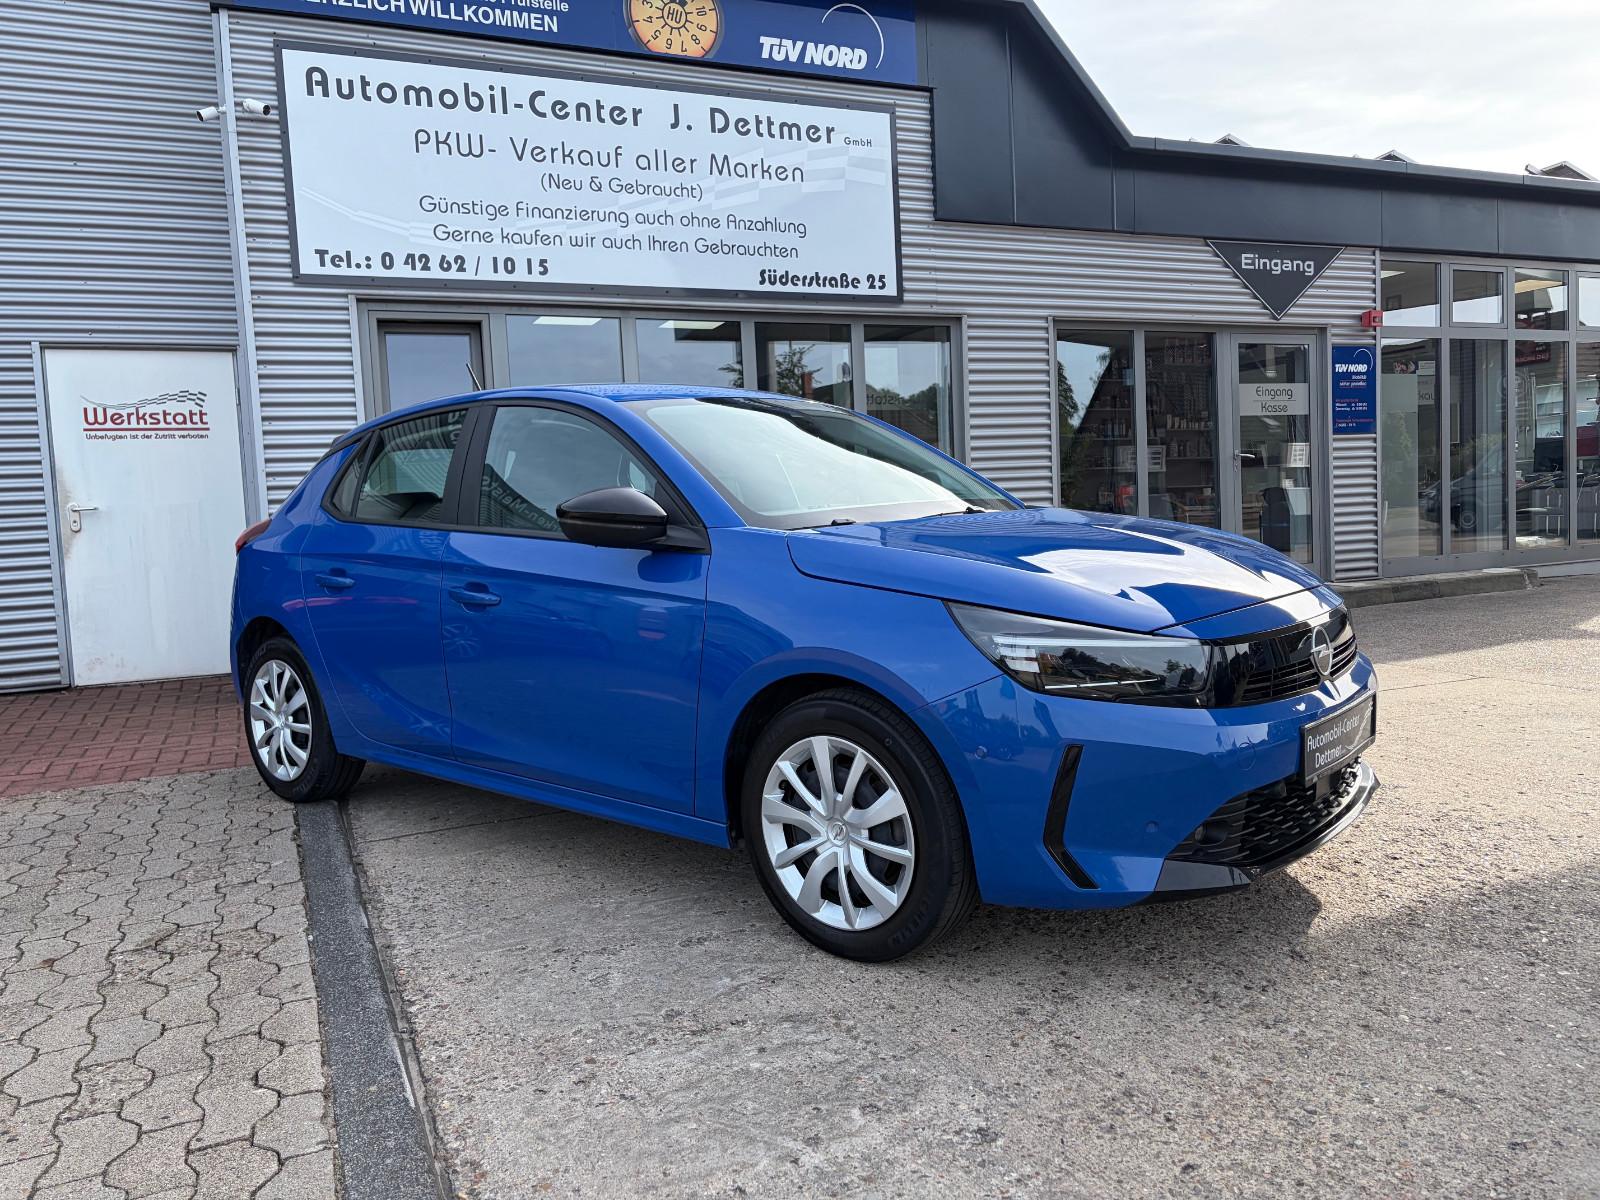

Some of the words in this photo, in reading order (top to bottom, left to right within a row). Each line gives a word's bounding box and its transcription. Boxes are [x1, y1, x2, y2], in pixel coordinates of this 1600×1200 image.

[408, 0, 558, 33] WILLKOMMEN
[666, 6, 683, 24] HU
[696, 5, 707, 17] 10
[804, 42, 868, 70] NORD
[305, 66, 643, 127] Automobil-Center
[670, 103, 693, 131] J.
[709, 107, 835, 144] Dettmer
[843, 136, 873, 148] GmbH
[414, 128, 497, 158] PKW-
[509, 136, 622, 168] Verkauf
[635, 148, 698, 174] aller
[709, 153, 804, 182] Marken
[540, 173, 583, 192] (Neu
[589, 176, 602, 192] &
[608, 177, 703, 201] Gebraucht)
[419, 195, 509, 221] Günstige
[516, 201, 629, 228] Finanzierung
[634, 210, 674, 227] auch
[680, 213, 721, 229] ohne
[727, 214, 807, 238] Anzahlung
[433, 223, 494, 244] Gerne
[501, 227, 563, 247] kaufen
[569, 234, 595, 249] wir
[602, 234, 642, 251] auch
[648, 235, 689, 253] Ihren
[694, 237, 799, 259] Gebrauchten
[314, 249, 373, 269] Tel.:
[381, 251, 395, 271] 0
[403, 253, 431, 271] 42
[438, 254, 467, 273] 62
[474, 255, 481, 276] /
[492, 256, 516, 275] 10
[526, 257, 549, 275] 15
[1241, 253, 1314, 275] Eingang
[759, 269, 861, 290] Süderstraße
[866, 273, 887, 290] 25
[1348, 364, 1368, 372] NORD
[1256, 386, 1293, 399] Eingang
[83, 406, 209, 426] Werkstatt
[1261, 402, 1288, 413] Kasse
[85, 433, 128, 441] Unbefugten
[1307, 715, 1361, 752] Automobil-Center
[1315, 745, 1342, 768] Dettmer
